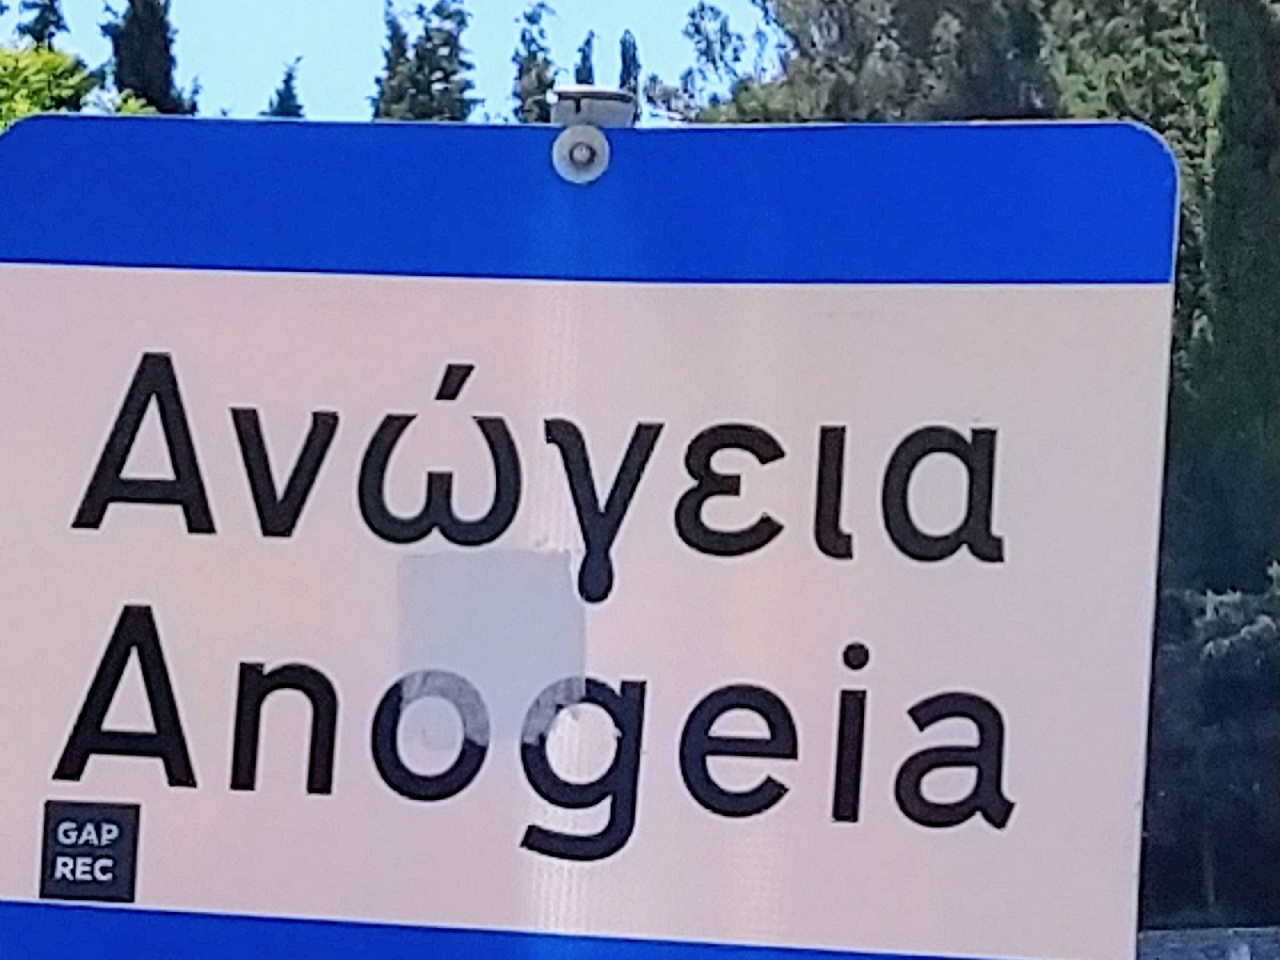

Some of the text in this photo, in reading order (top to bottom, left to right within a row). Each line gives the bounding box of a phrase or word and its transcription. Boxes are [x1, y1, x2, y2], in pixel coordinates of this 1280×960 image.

[71, 352, 1005, 603] Ανώγεια
[52, 605, 1016, 861] Anogeia
[54, 856, 114, 881] REC
[57, 820, 119, 846] GAP
